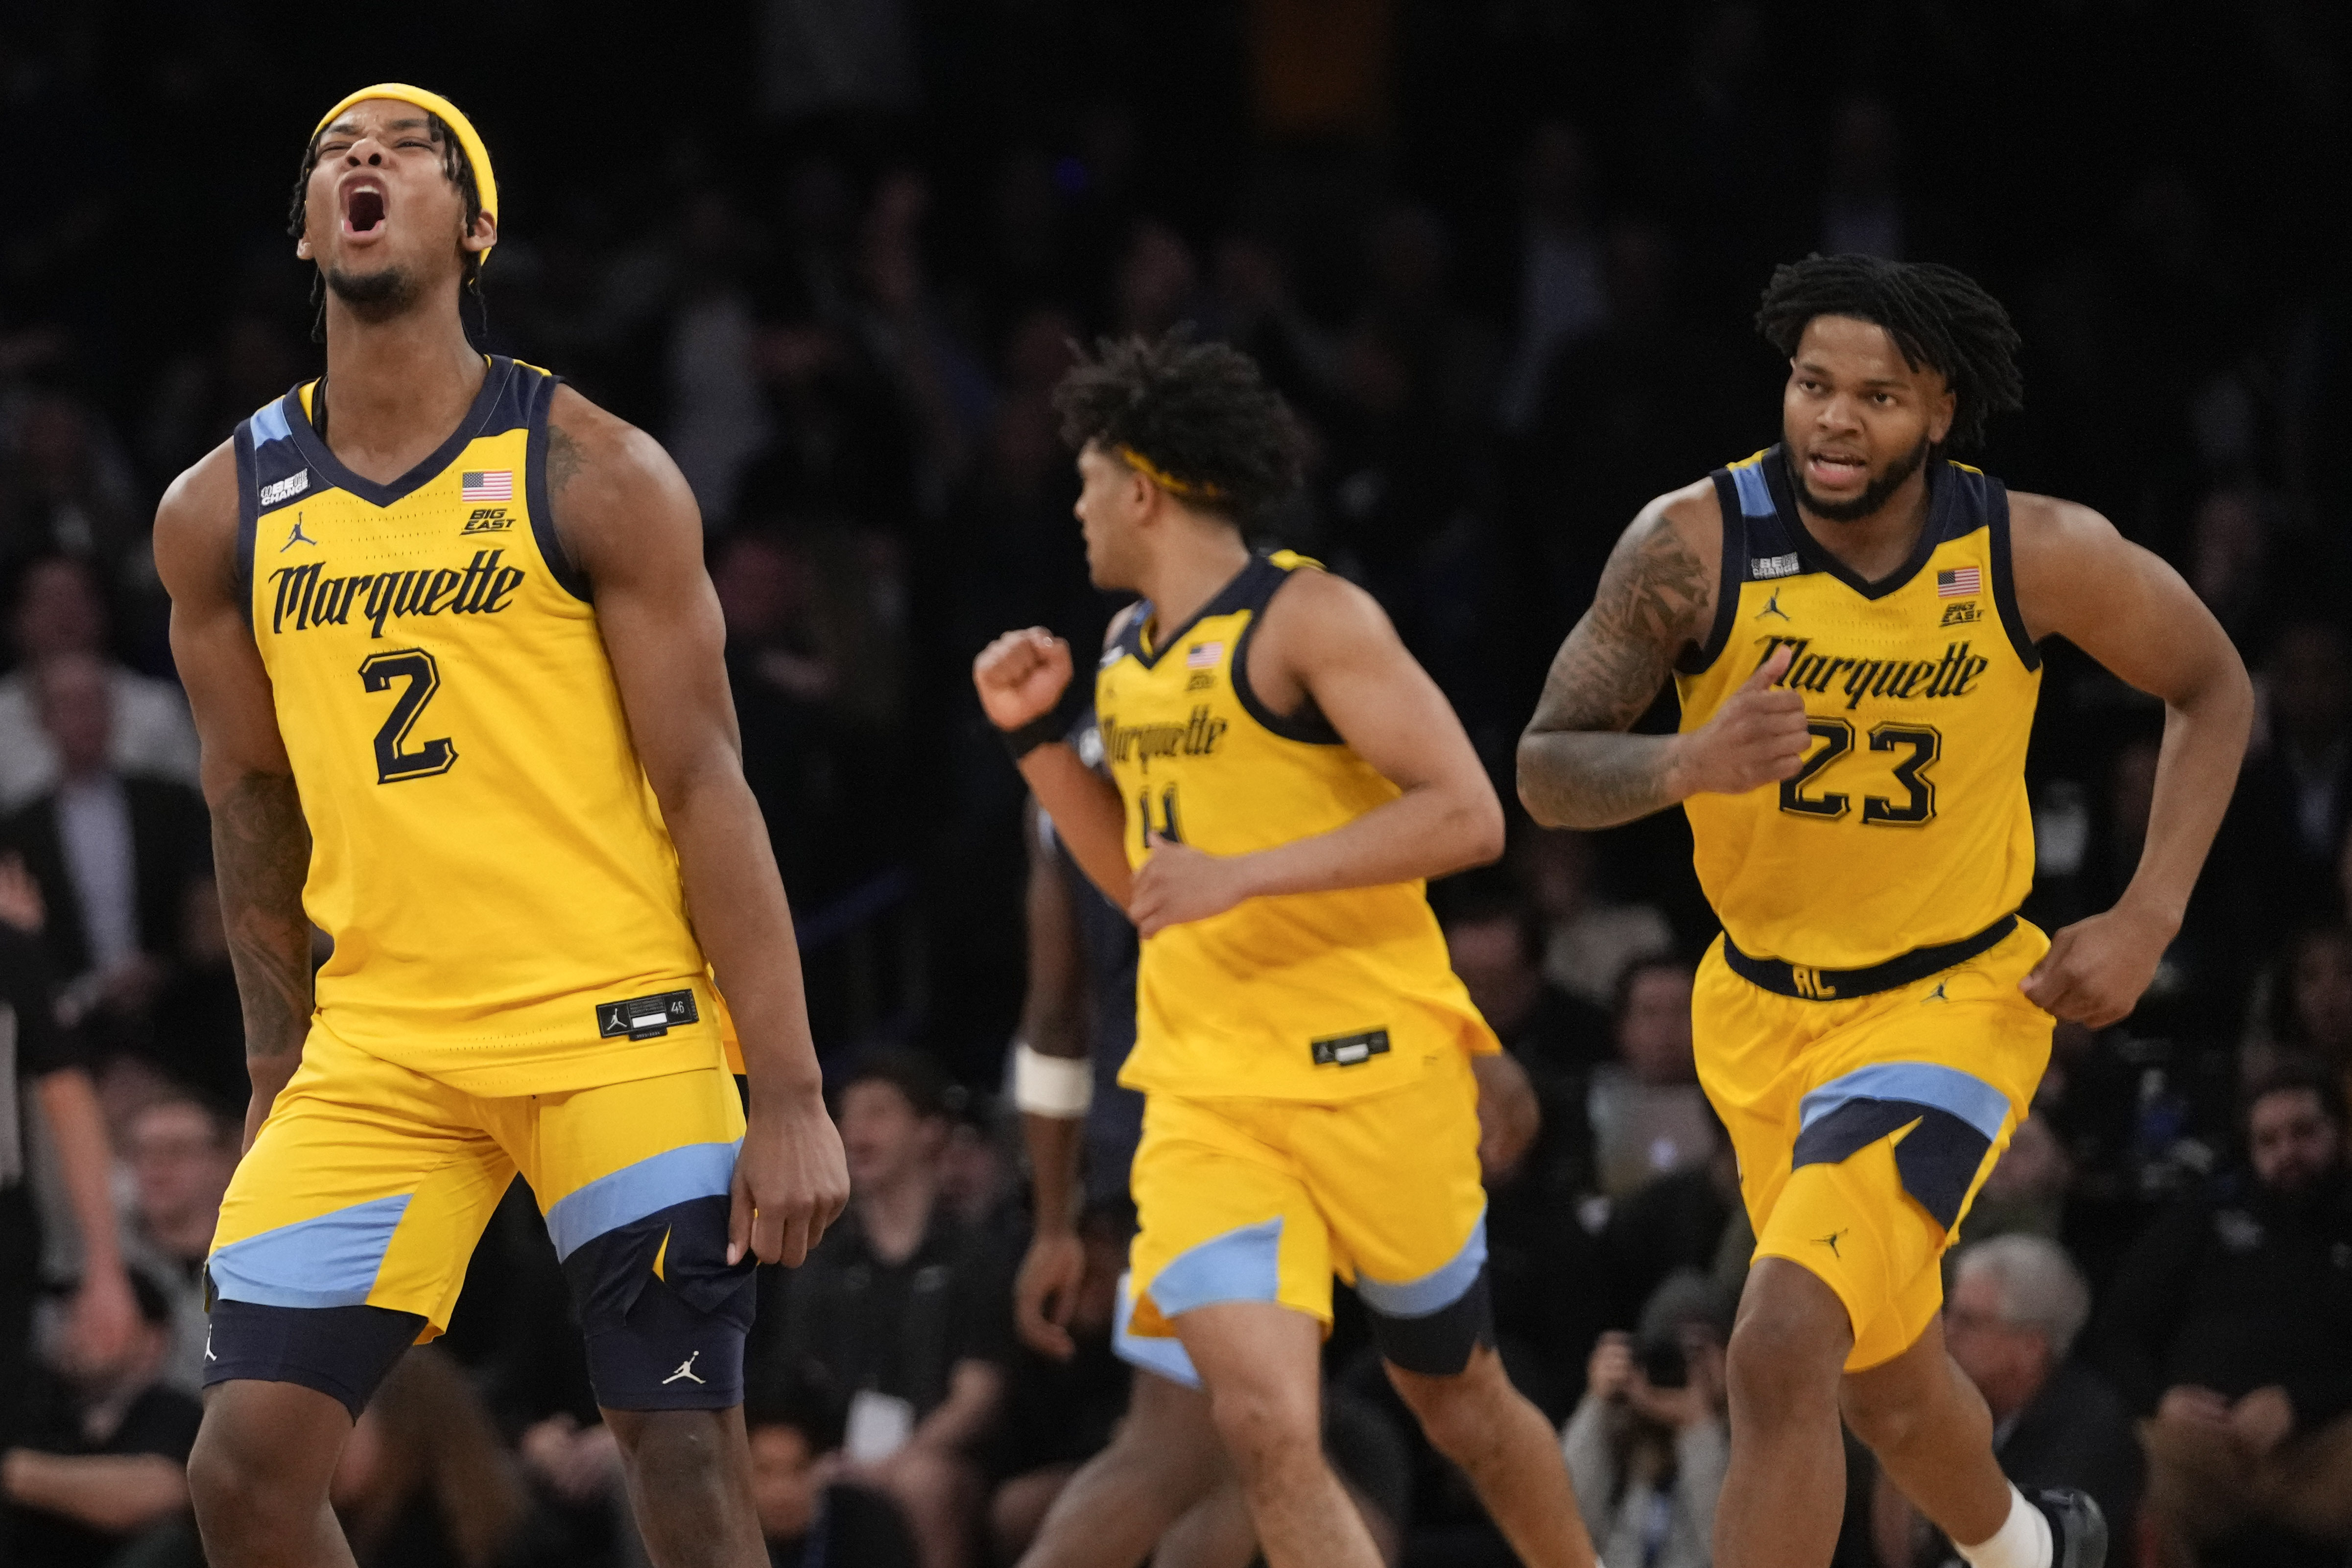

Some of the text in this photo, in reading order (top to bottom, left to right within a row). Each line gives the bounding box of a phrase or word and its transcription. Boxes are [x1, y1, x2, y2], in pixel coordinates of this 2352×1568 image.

[272, 475, 294, 494] BE
[470, 508, 508, 520] BIG
[464, 518, 517, 530] EAST
[1760, 556, 1783, 569] BE
[268, 548, 526, 639] Marquette
[1754, 635, 1989, 709] Marquette
[357, 646, 459, 785] 2
[1779, 715, 1943, 828] 23
[671, 1000, 685, 1014] 46
